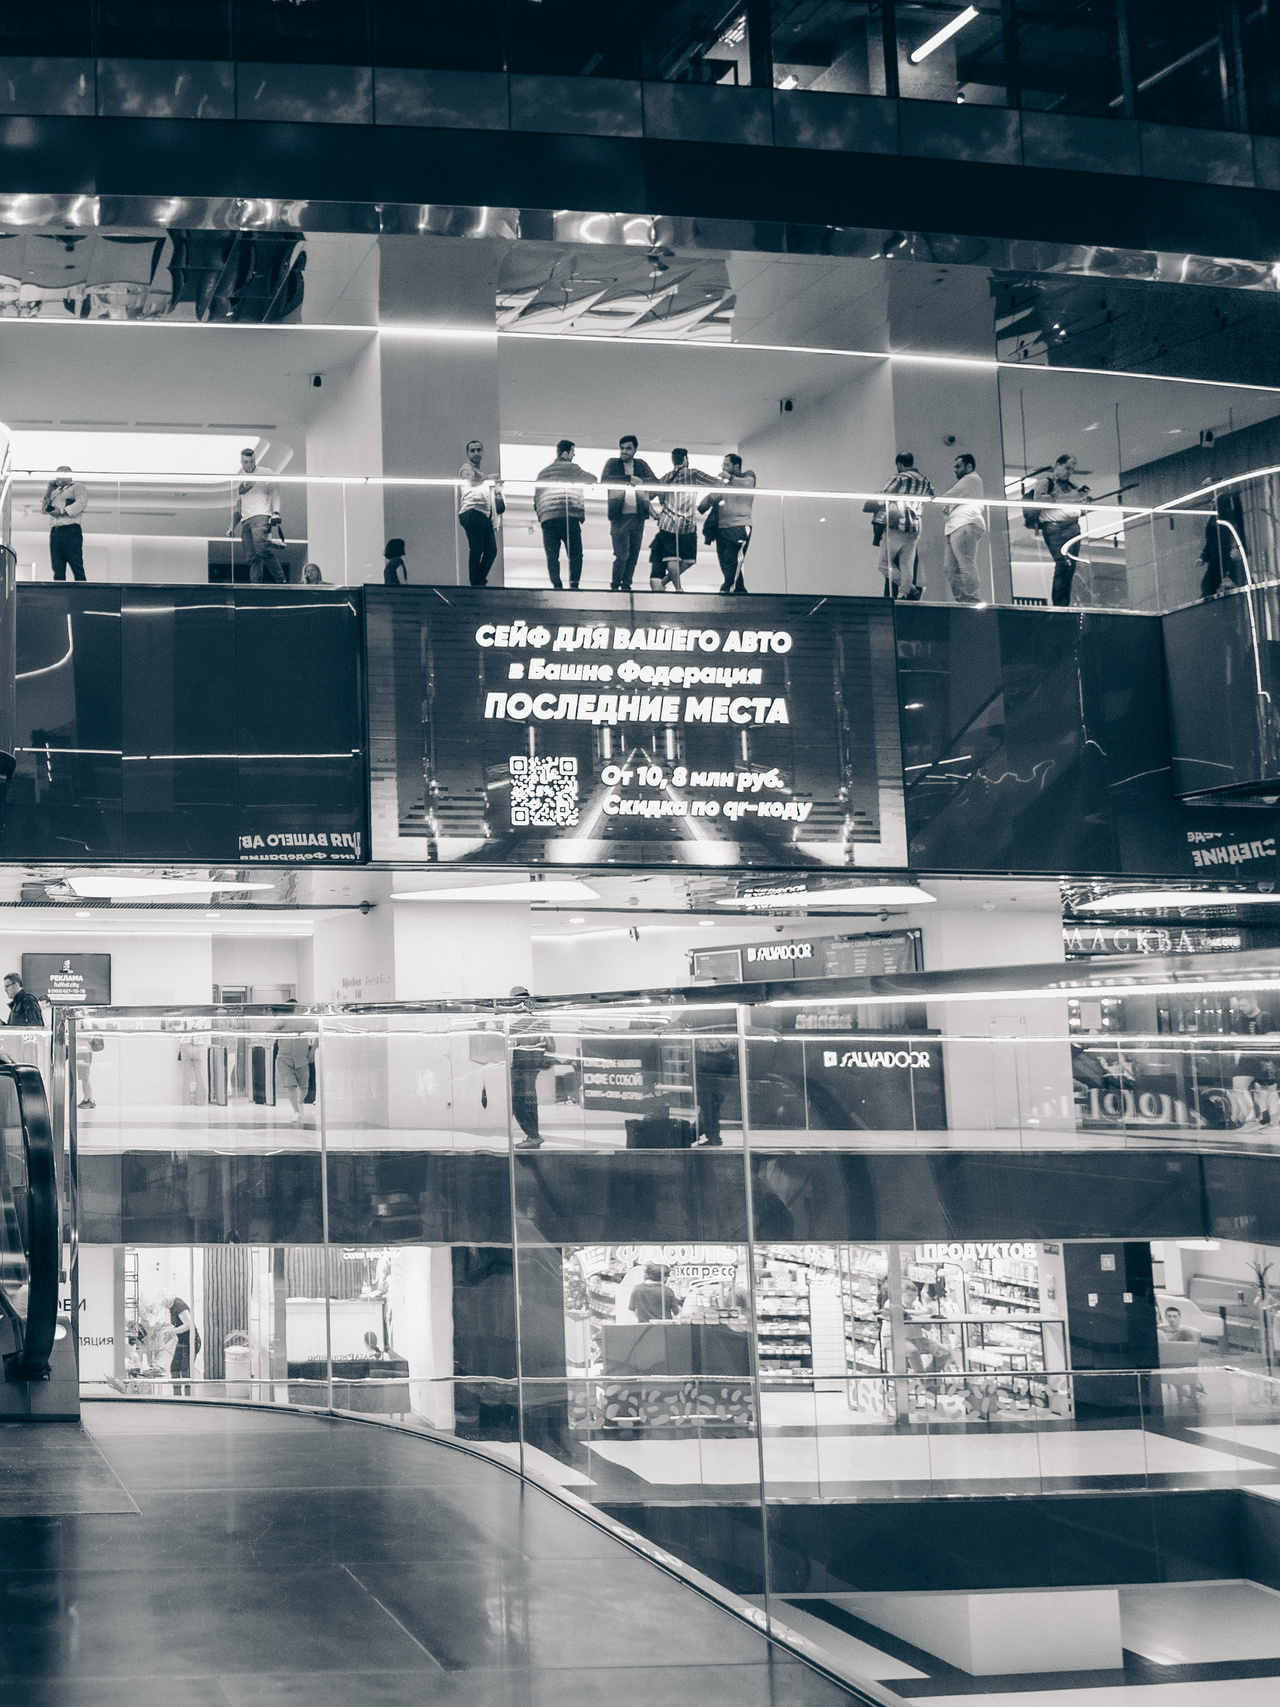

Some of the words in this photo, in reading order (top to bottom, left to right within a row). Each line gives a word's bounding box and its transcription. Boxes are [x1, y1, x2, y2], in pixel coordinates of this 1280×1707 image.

[475, 620, 551, 648] СЕЙФ
[552, 626, 610, 652] ДЛЯ
[613, 628, 720, 652] ВАШЕГО
[722, 630, 793, 653] АВТО
[508, 663, 525, 680] в
[528, 657, 613, 682] Башне
[617, 659, 763, 688] Федерация
[484, 692, 681, 726] ПОСЛЕДНИЕ
[684, 696, 790, 724] МЕСТА
[601, 765, 634, 787] От
[671, 766, 688, 787] 8
[690, 771, 735, 788] млн
[736, 767, 785, 792] руб.
[601, 794, 688, 819] Скидка
[690, 801, 720, 816] по
[722, 801, 813, 822] qr-коду
[756, 943, 813, 962] SALVADOOR
[49, 974, 84, 982] РЕКЛАМА
[839, 1051, 931, 1069] SALVADOOR
[615, 1072, 644, 1086] СОБОЙ
[923, 1243, 1037, 1262] ПРОДУКТОВ
